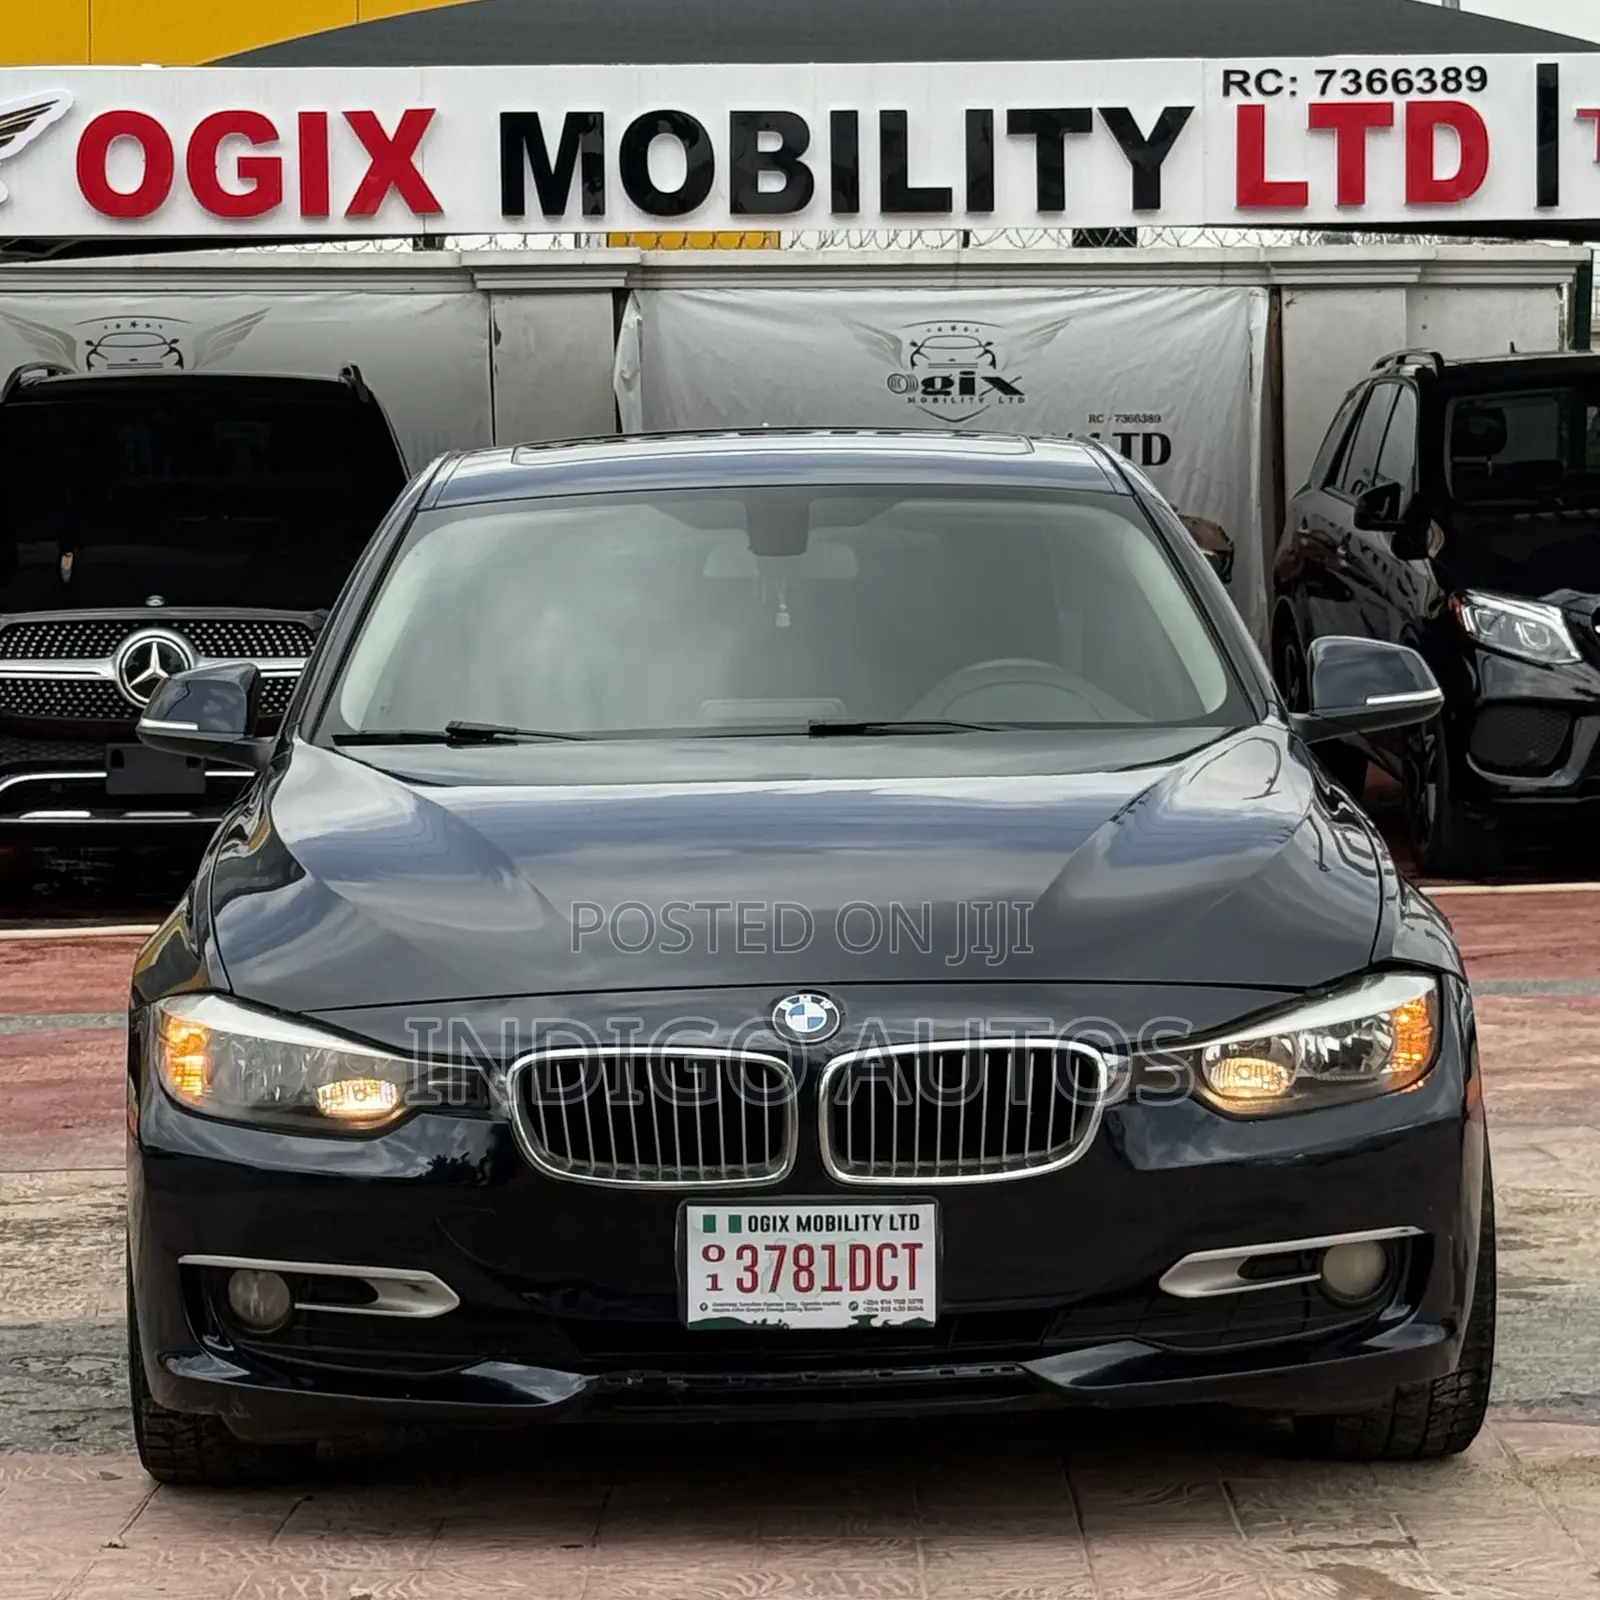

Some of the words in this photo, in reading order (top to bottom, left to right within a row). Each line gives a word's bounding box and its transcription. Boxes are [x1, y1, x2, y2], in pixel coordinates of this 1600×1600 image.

[1222, 69, 1298, 97] RC:
[1314, 65, 1488, 97] 7366389
[76, 108, 444, 219] OGIX
[500, 106, 1195, 218] MOBILITY
[1236, 101, 1490, 208] LTD
[906, 396, 985, 404] MOBILITY
[998, 396, 1026, 404] LTD
[1089, 432, 1172, 467] TD
[748, 1214, 790, 1233] OGIX
[796, 1214, 883, 1233] MOBILITY
[889, 1213, 920, 1232] LTD
[735, 1242, 924, 1294] 3781DCT
